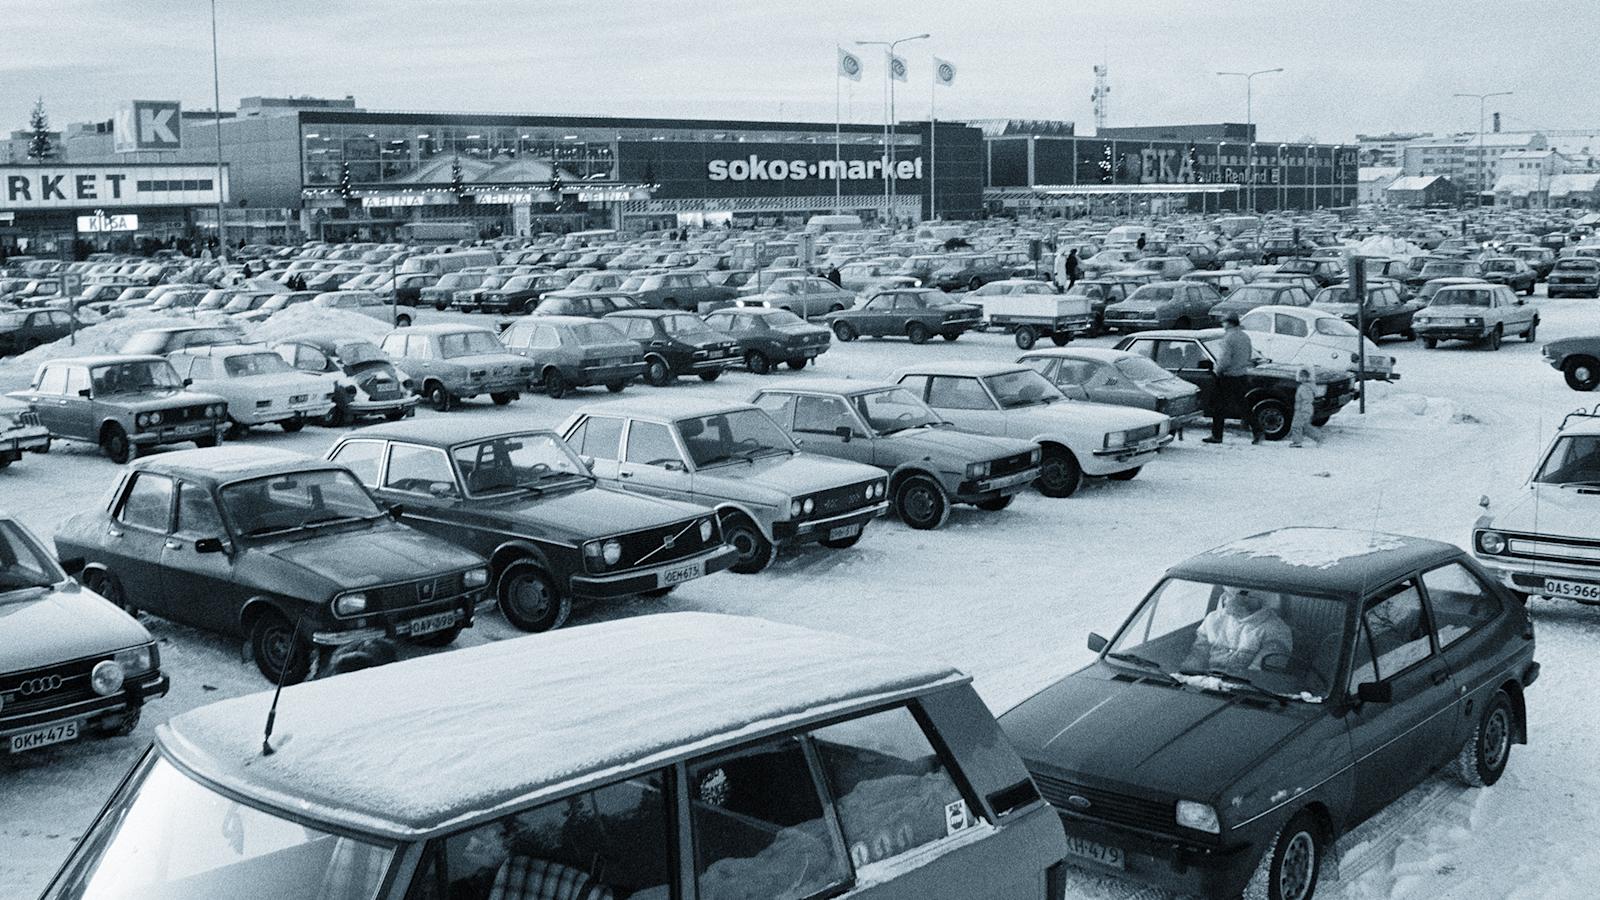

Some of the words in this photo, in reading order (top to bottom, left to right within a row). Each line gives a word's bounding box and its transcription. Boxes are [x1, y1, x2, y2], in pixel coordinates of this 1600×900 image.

[141, 109, 178, 142] K
[1141, 149, 1195, 183] EKA
[8, 174, 126, 201] RKET
[64, 275, 79, 295] P
[1546, 582, 1598, 598] OAS-966
[14, 724, 76, 749] OKM-475
